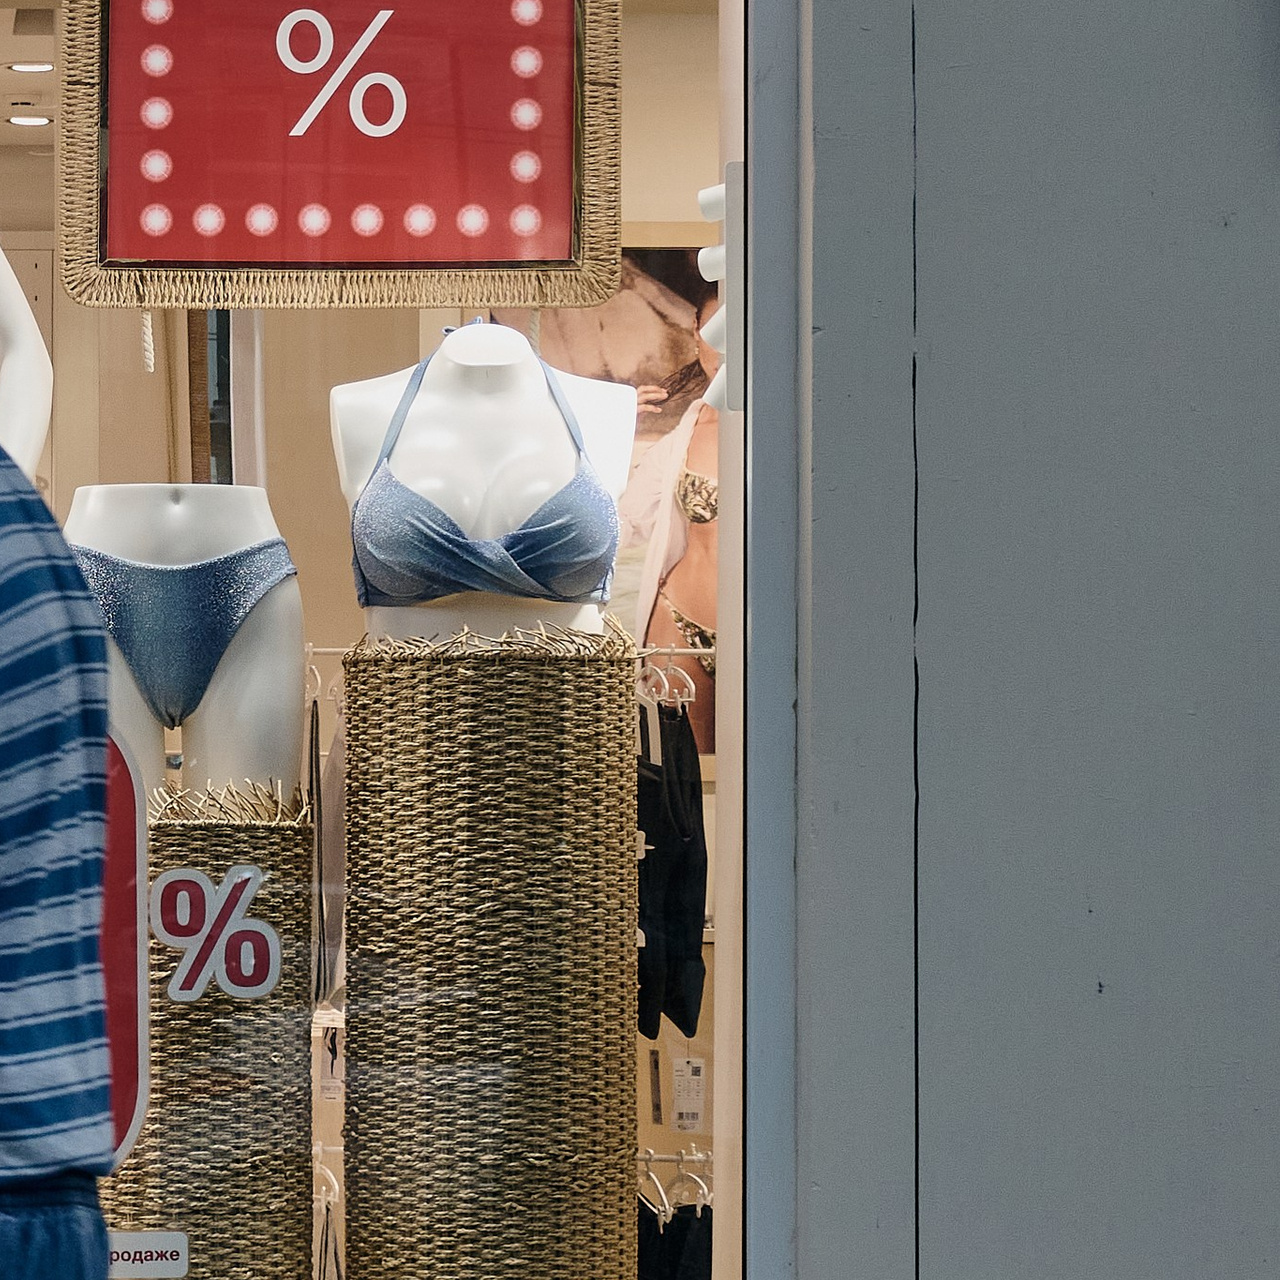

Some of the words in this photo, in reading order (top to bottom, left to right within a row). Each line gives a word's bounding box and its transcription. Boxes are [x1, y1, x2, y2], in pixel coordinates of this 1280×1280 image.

[275, 8, 407, 138] %
[153, 867, 278, 1000] %
[109, 1249, 180, 1265] родаже
